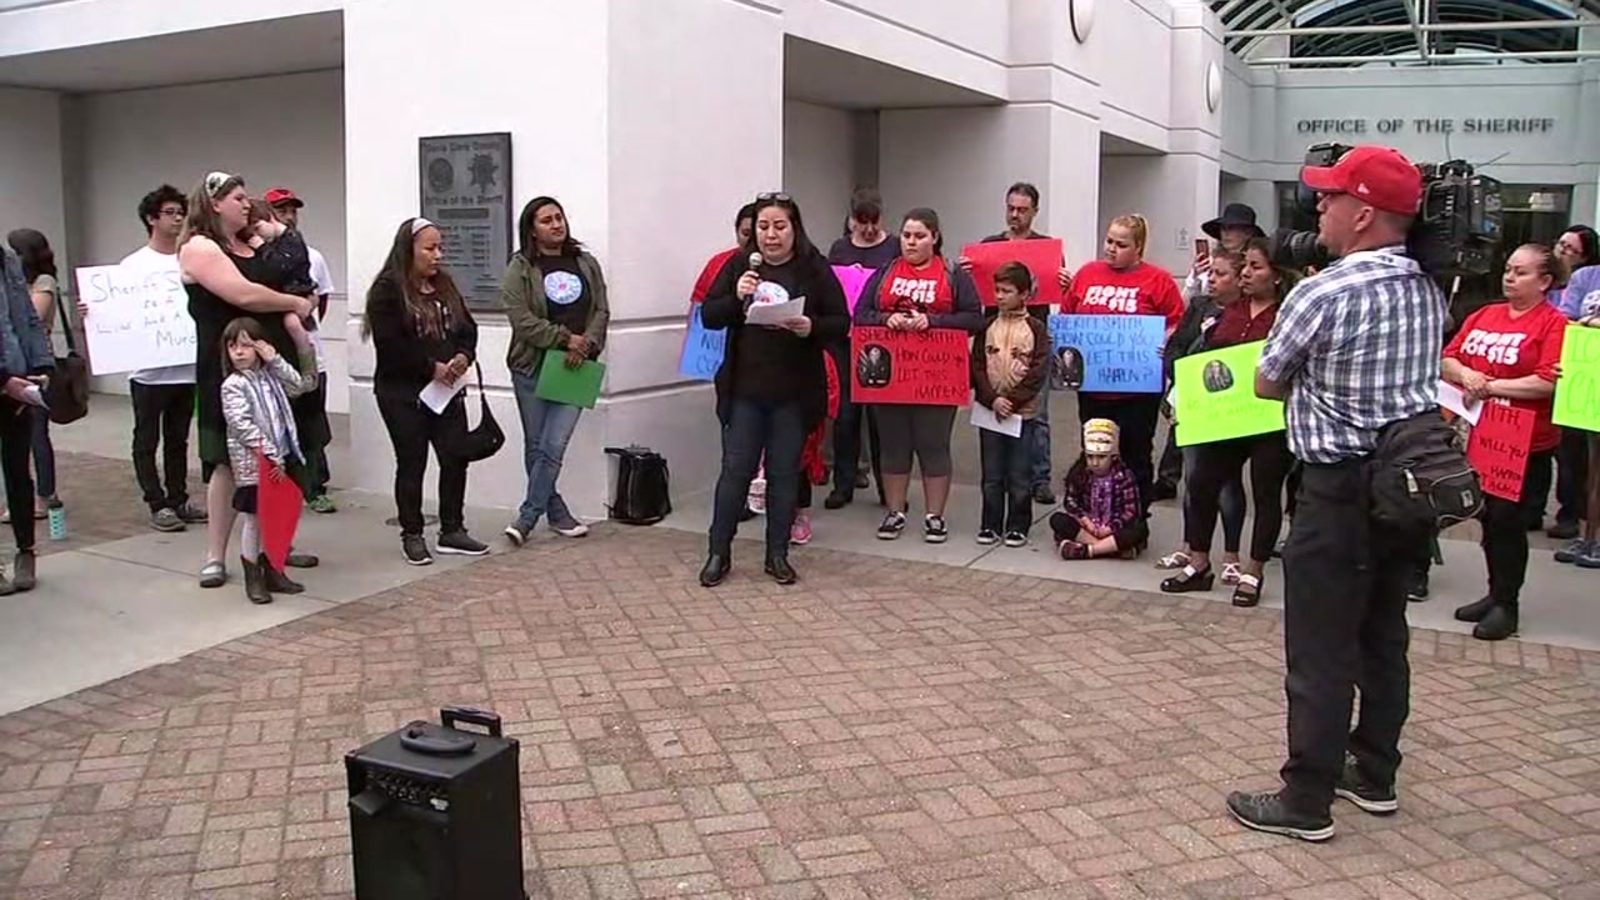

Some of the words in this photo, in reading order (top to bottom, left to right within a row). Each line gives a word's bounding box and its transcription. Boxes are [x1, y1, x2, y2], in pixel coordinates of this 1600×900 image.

[1297, 118, 1367, 134] OFFICE
[1376, 118, 1405, 134] OF
[1413, 118, 1454, 134] THE
[1463, 117, 1554, 134] SHERIFF
[893, 276, 937, 290] FIGHT
[1086, 285, 1140, 298] FIGHT
[911, 290, 936, 304] $15
[1083, 295, 1107, 306] FOR
[1108, 297, 1138, 313] $15
[1466, 329, 1528, 347] FIGHT
[1460, 341, 1487, 356] FOR
[1487, 345, 1520, 365] $15
